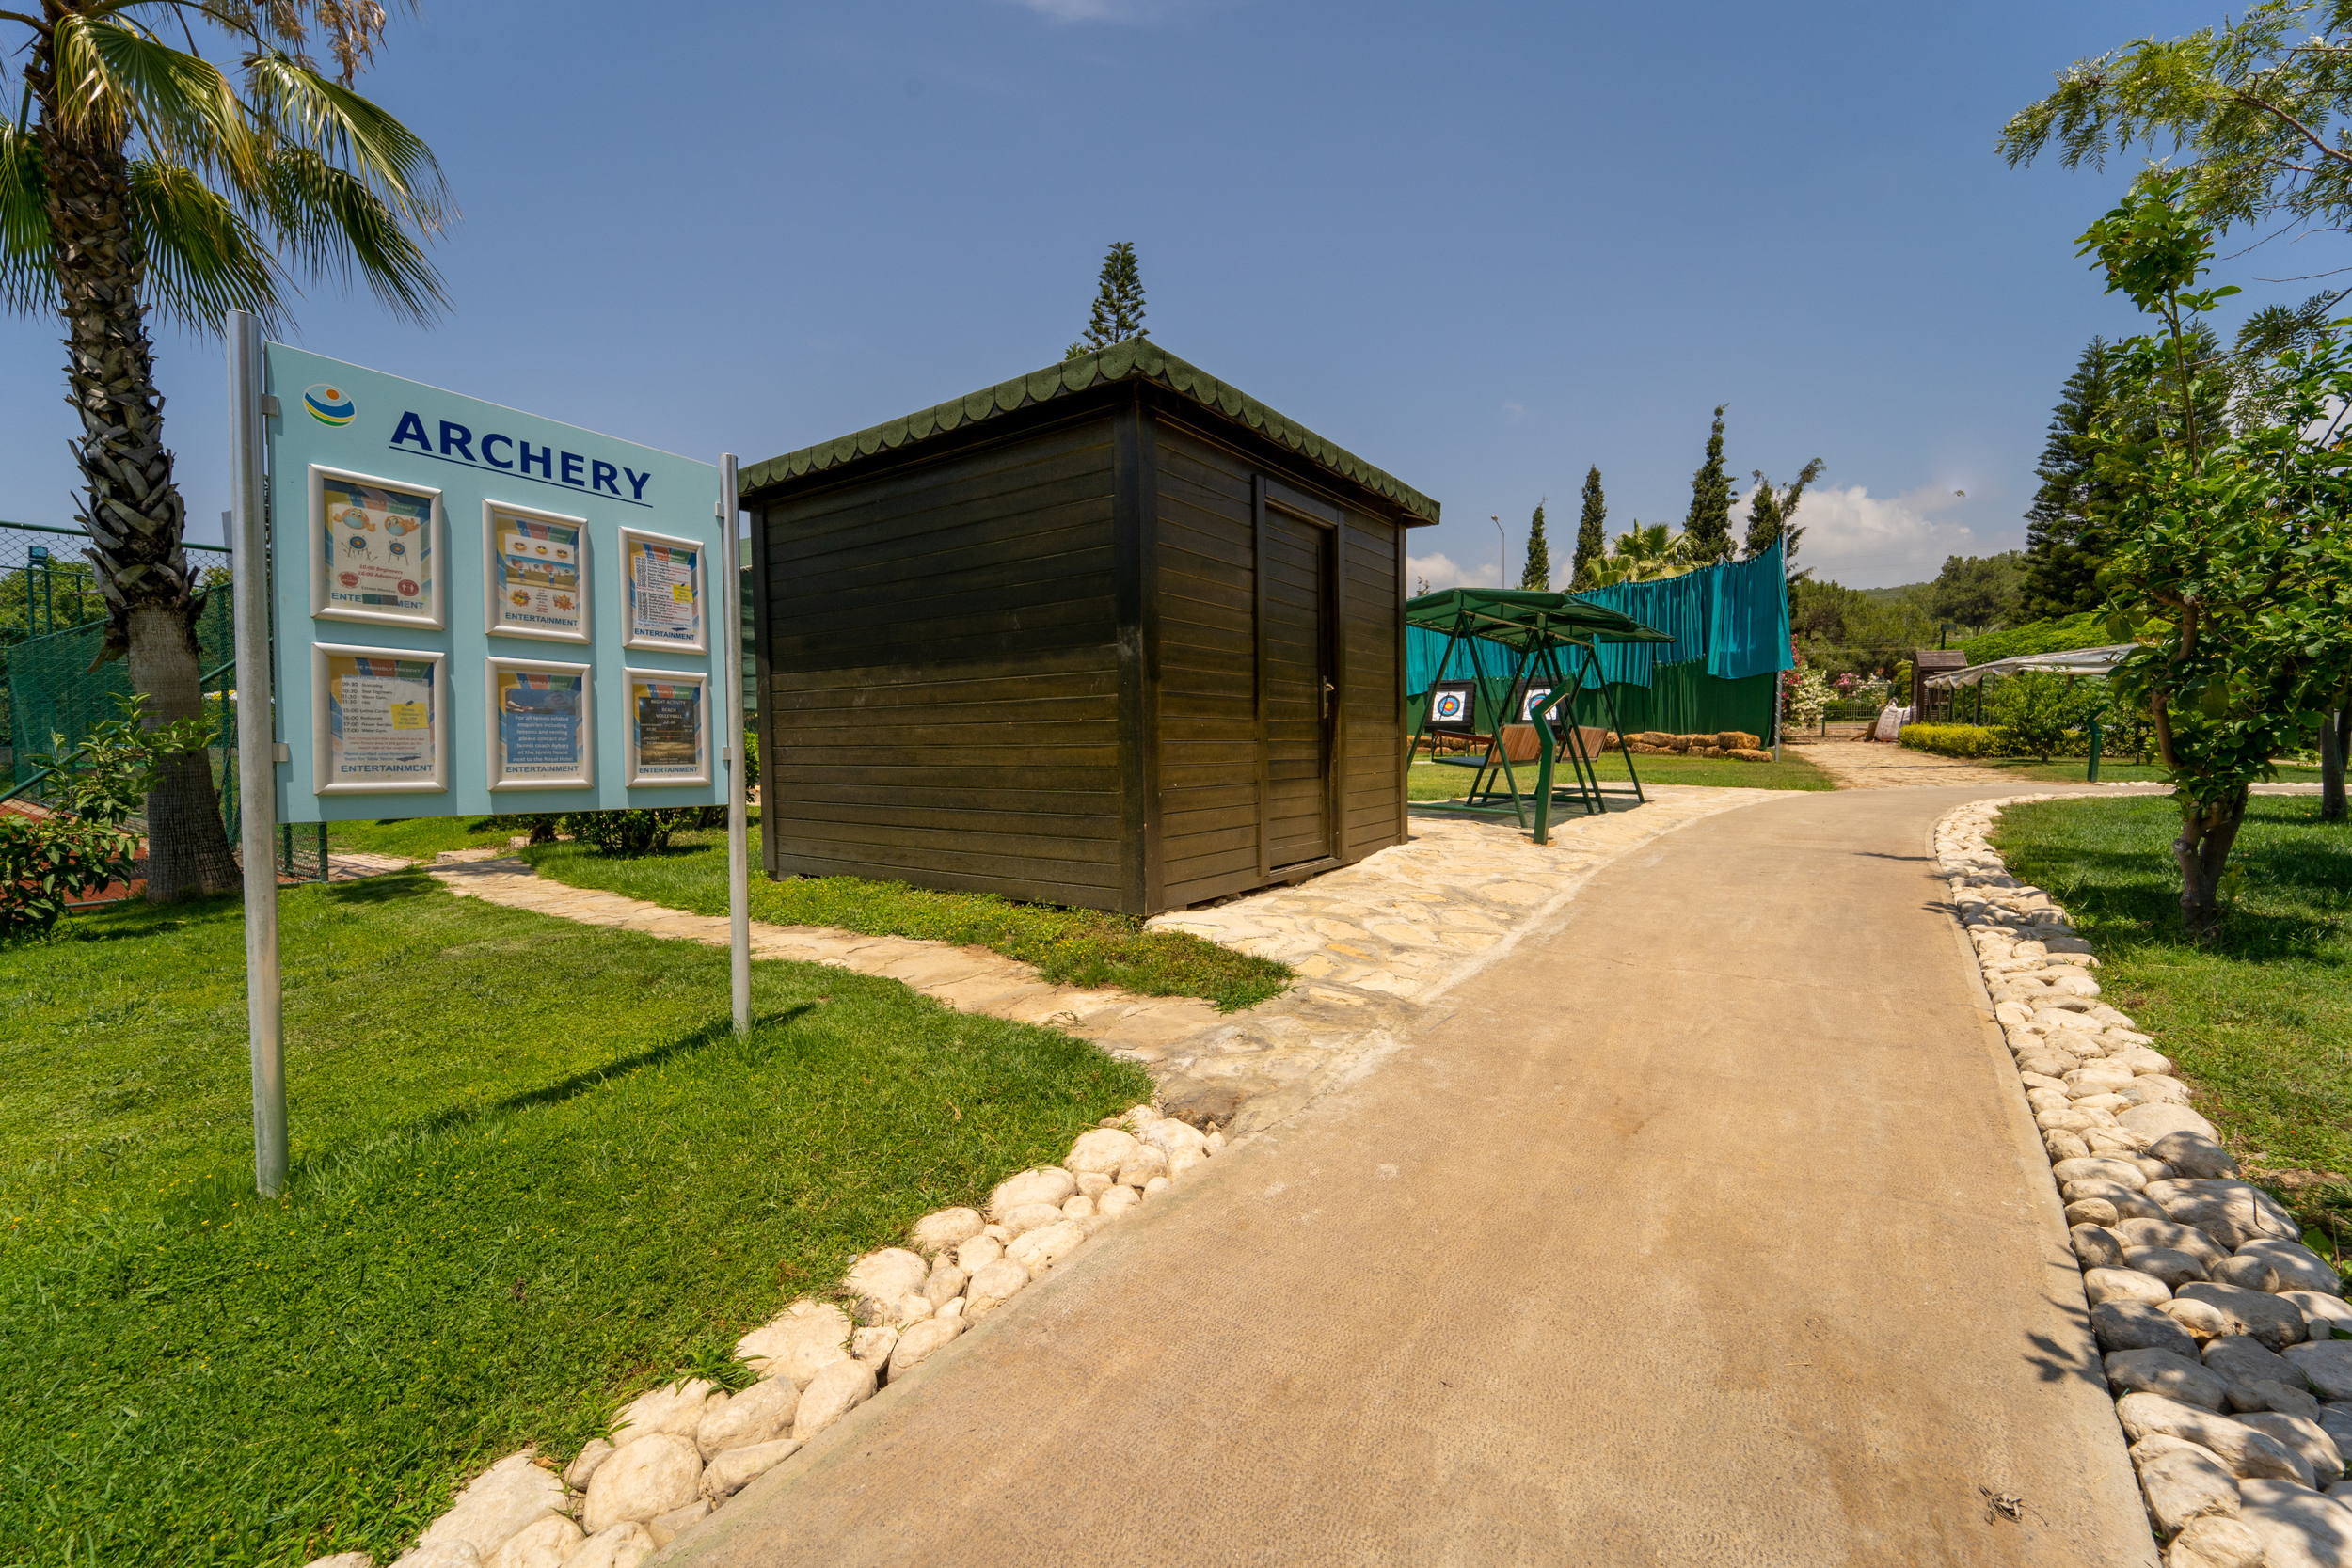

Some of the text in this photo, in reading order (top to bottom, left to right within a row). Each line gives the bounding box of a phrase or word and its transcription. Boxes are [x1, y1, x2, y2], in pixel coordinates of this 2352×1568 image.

[390, 410, 651, 500] ARCHERY
[357, 497, 385, 506] PROUDLY
[387, 502, 412, 511] PRESENT
[505, 612, 578, 626] ENTERTAINMENT
[635, 628, 695, 640] ENTERTAINMENT
[341, 764, 433, 773] ENTERTAINMENT
